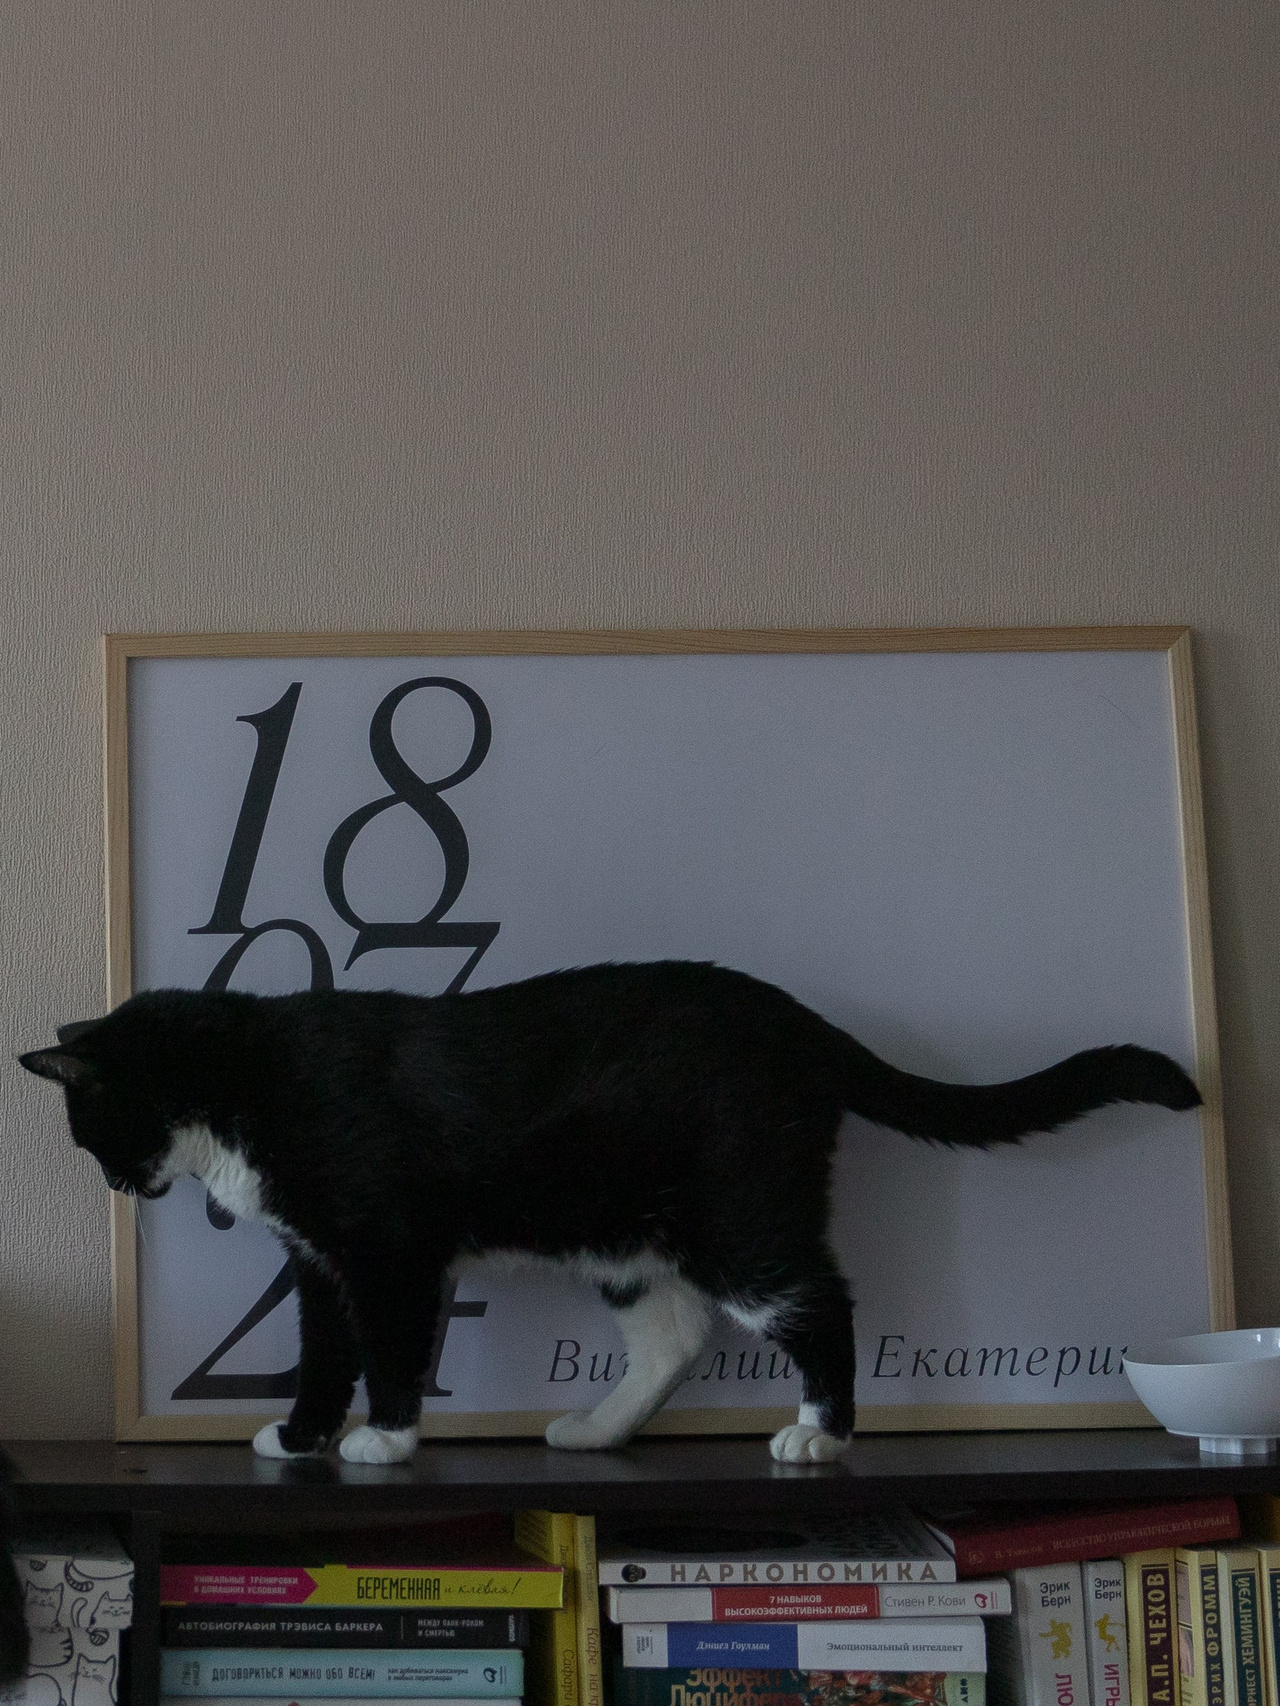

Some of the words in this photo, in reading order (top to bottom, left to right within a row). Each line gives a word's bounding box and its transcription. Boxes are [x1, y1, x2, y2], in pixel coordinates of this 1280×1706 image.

[187, 676, 492, 935] 18
[545, 1339, 797, 1383] Вилий
[671, 1562, 937, 1582] НАРКОНОМИКА
[356, 1576, 441, 1601] БЕРЕМЕННАЯ
[1040, 1581, 1070, 1595] Эрик
[1094, 1577, 1122, 1589] Эрик
[770, 1595, 776, 1604] 7
[776, 1594, 822, 1604] НАВЫКОВ
[884, 1596, 925, 1607] Стивен
[927, 1595, 936, 1606] Р.
[938, 1594, 966, 1606] Кови
[1041, 1595, 1071, 1608] Берн
[1094, 1589, 1122, 1601] Берн
[724, 1606, 833, 1616] ВЫСОКОЭФФЕКТИВНЫХ
[834, 1604, 868, 1615] ЛЮДЕЙ
[1146, 1573, 1167, 1646] ЧЕХОВ
[1203, 1574, 1219, 1657] ФРОММ
[178, 1621, 277, 1631] АВТОБИОГРАФИЯ
[280, 1622, 332, 1631] ТРЭВИСА
[335, 1622, 383, 1632] БАРКЕРА
[1235, 1577, 1255, 1666] ХЕМИНГУЭЙ
[586, 1627, 600, 1665] Кафе
[695, 1641, 729, 1650] Дэниел
[730, 1641, 770, 1652] Гоулман
[826, 1641, 910, 1653] Эмоциональный
[912, 1643, 964, 1652] интеллект
[212, 1667, 284, 1682] ДОГОВОРИТЬСЯ
[289, 1667, 322, 1681] МОЖНО
[562, 1649, 575, 1701] Сафари
[1211, 1662, 1223, 1705] ЭРИХ
